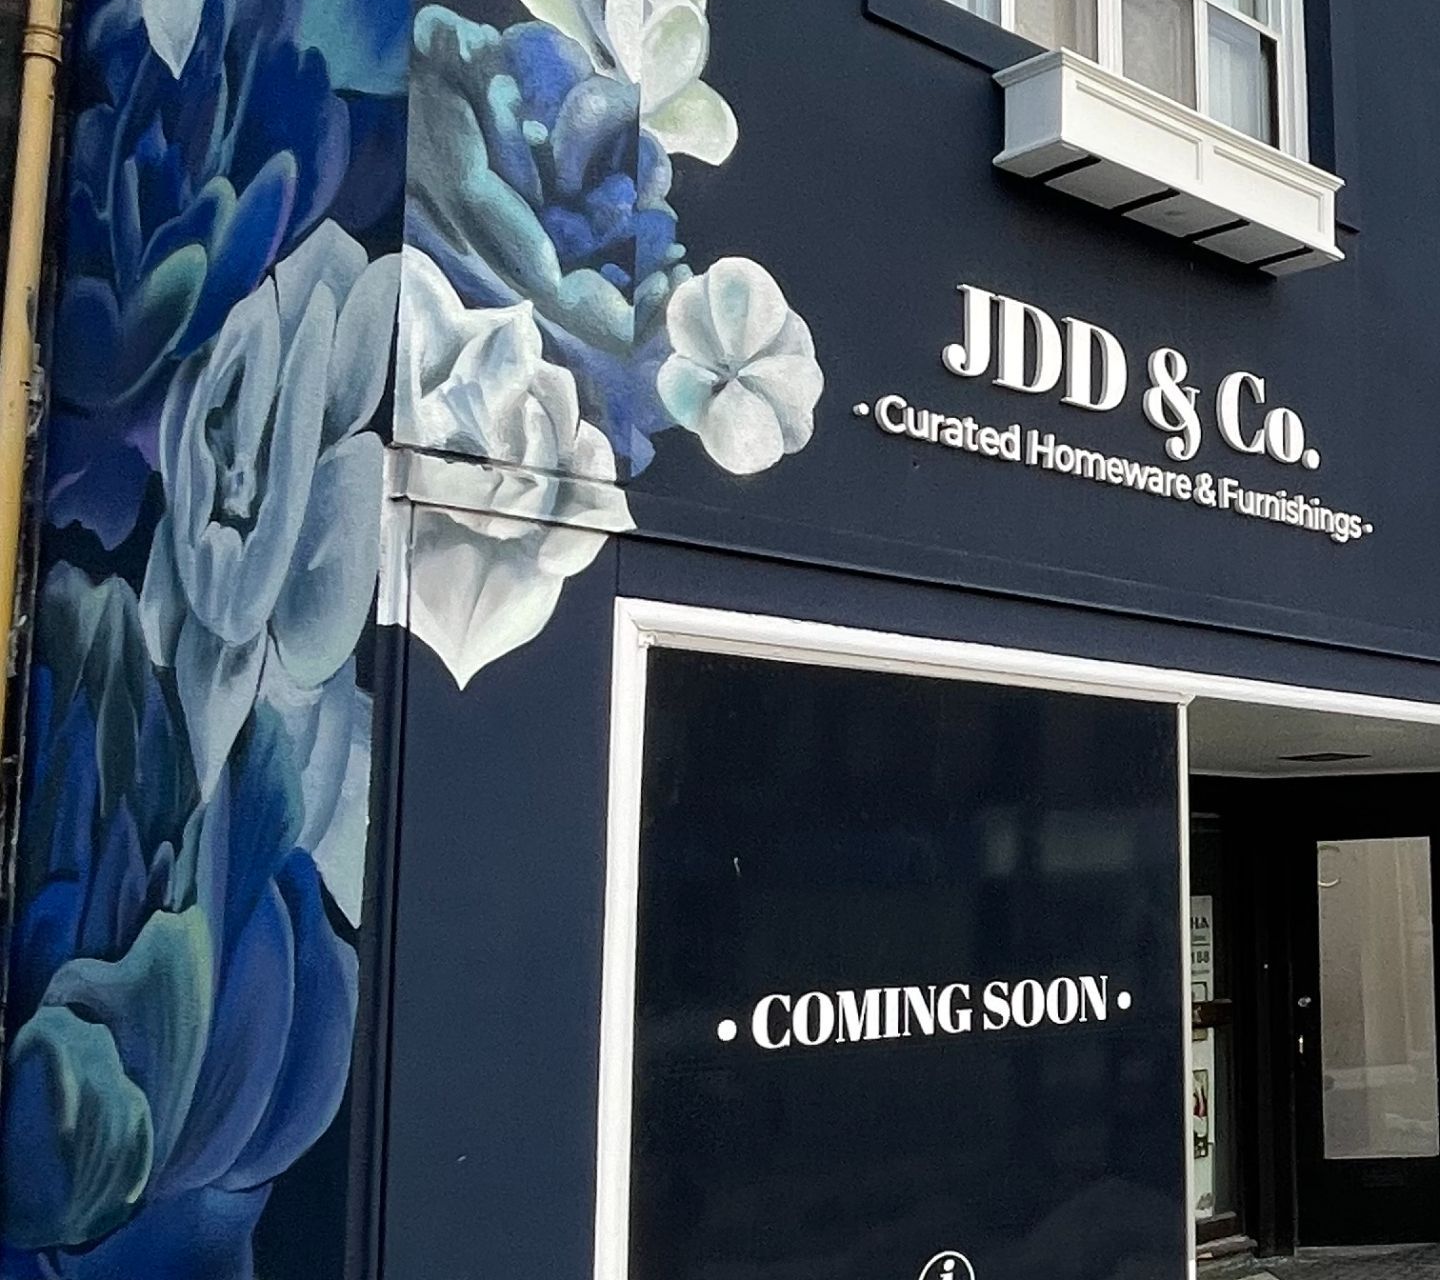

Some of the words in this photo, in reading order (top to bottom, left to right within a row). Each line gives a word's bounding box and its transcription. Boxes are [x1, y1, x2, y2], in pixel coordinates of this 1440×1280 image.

[942, 283, 1128, 412] JDD
[1143, 347, 1202, 463] &
[1216, 371, 1323, 470] Co.
[874, 395, 1021, 462] Curated
[1026, 429, 1193, 501] Homeware
[1192, 473, 1217, 507] &
[1218, 478, 1363, 543] Furnishings
[751, 983, 973, 1049] COMING
[982, 975, 1109, 1032] SOON
